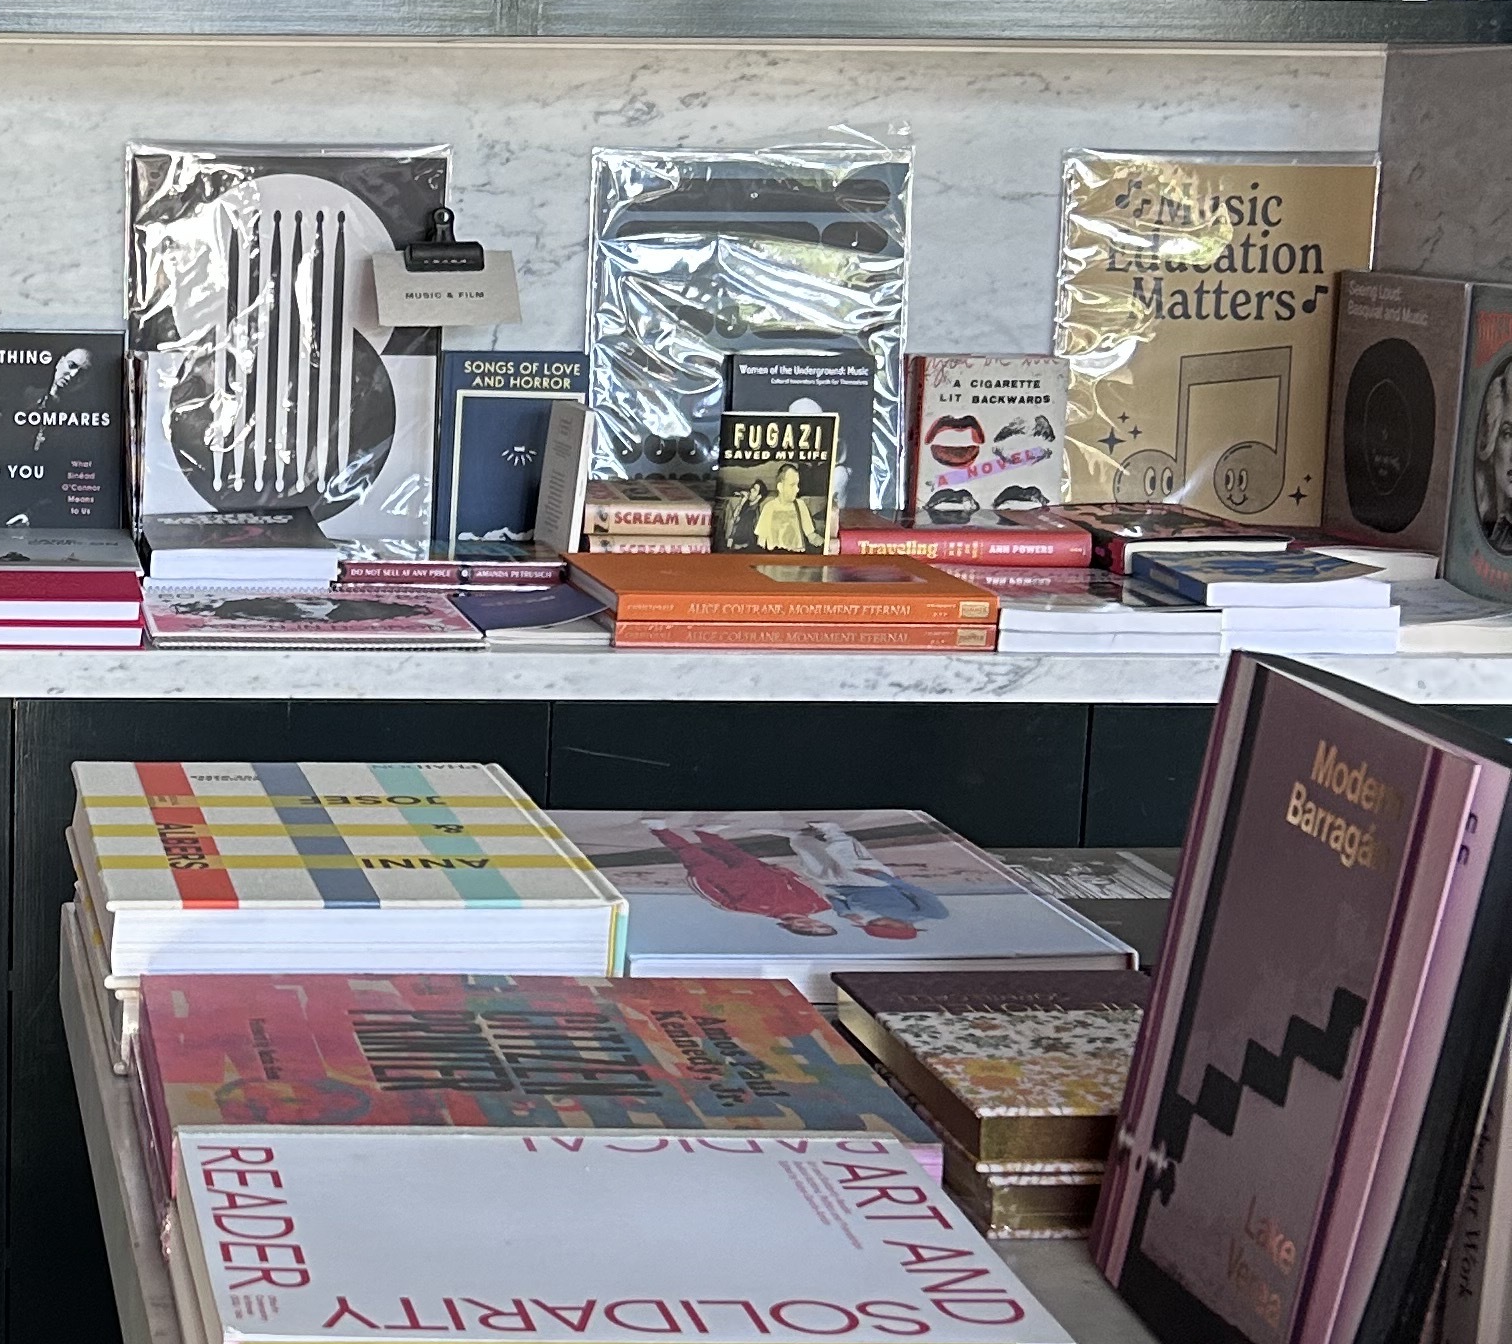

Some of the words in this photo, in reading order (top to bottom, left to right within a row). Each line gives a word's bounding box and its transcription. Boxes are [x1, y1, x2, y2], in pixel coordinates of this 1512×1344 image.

[1130, 276, 1296, 321] Matters
[464, 361, 515, 374] SONGS
[520, 362, 538, 375] OF
[544, 363, 581, 376] LOVE
[472, 377, 504, 388] AND
[510, 376, 571, 389] HORROR
[953, 379, 961, 388] A
[970, 379, 1041, 389] CIGARETTE
[939, 393, 963, 404] LIT
[972, 394, 1051, 405] BACKWARDS
[14, 411, 111, 427] COMPARES
[733, 422, 823, 449] FUGAZI
[724, 450, 770, 460] SAVED
[773, 450, 796, 460] MY
[800, 451, 827, 460] LIFE
[8, 465, 44, 479] YOU
[858, 541, 938, 558] Traveling
[989, 544, 1004, 554] ANN
[1007, 544, 1054, 555] POWERS
[688, 603, 721, 615] ALICE
[722, 603, 787, 616] COLTRANE,
[790, 604, 860, 616] MONUMENT
[860, 605, 911, 616] ETERNAL
[298, 795, 447, 805] JOSEF
[431, 823, 465, 834] &
[155, 820, 210, 871] ALBERS
[360, 858, 491, 870] ANNI
[821, 1160, 954, 1231] ART
[197, 1144, 312, 1292] READER
[881, 1238, 1027, 1328] AND
[321, 1295, 933, 1337] SOLIDARITY
